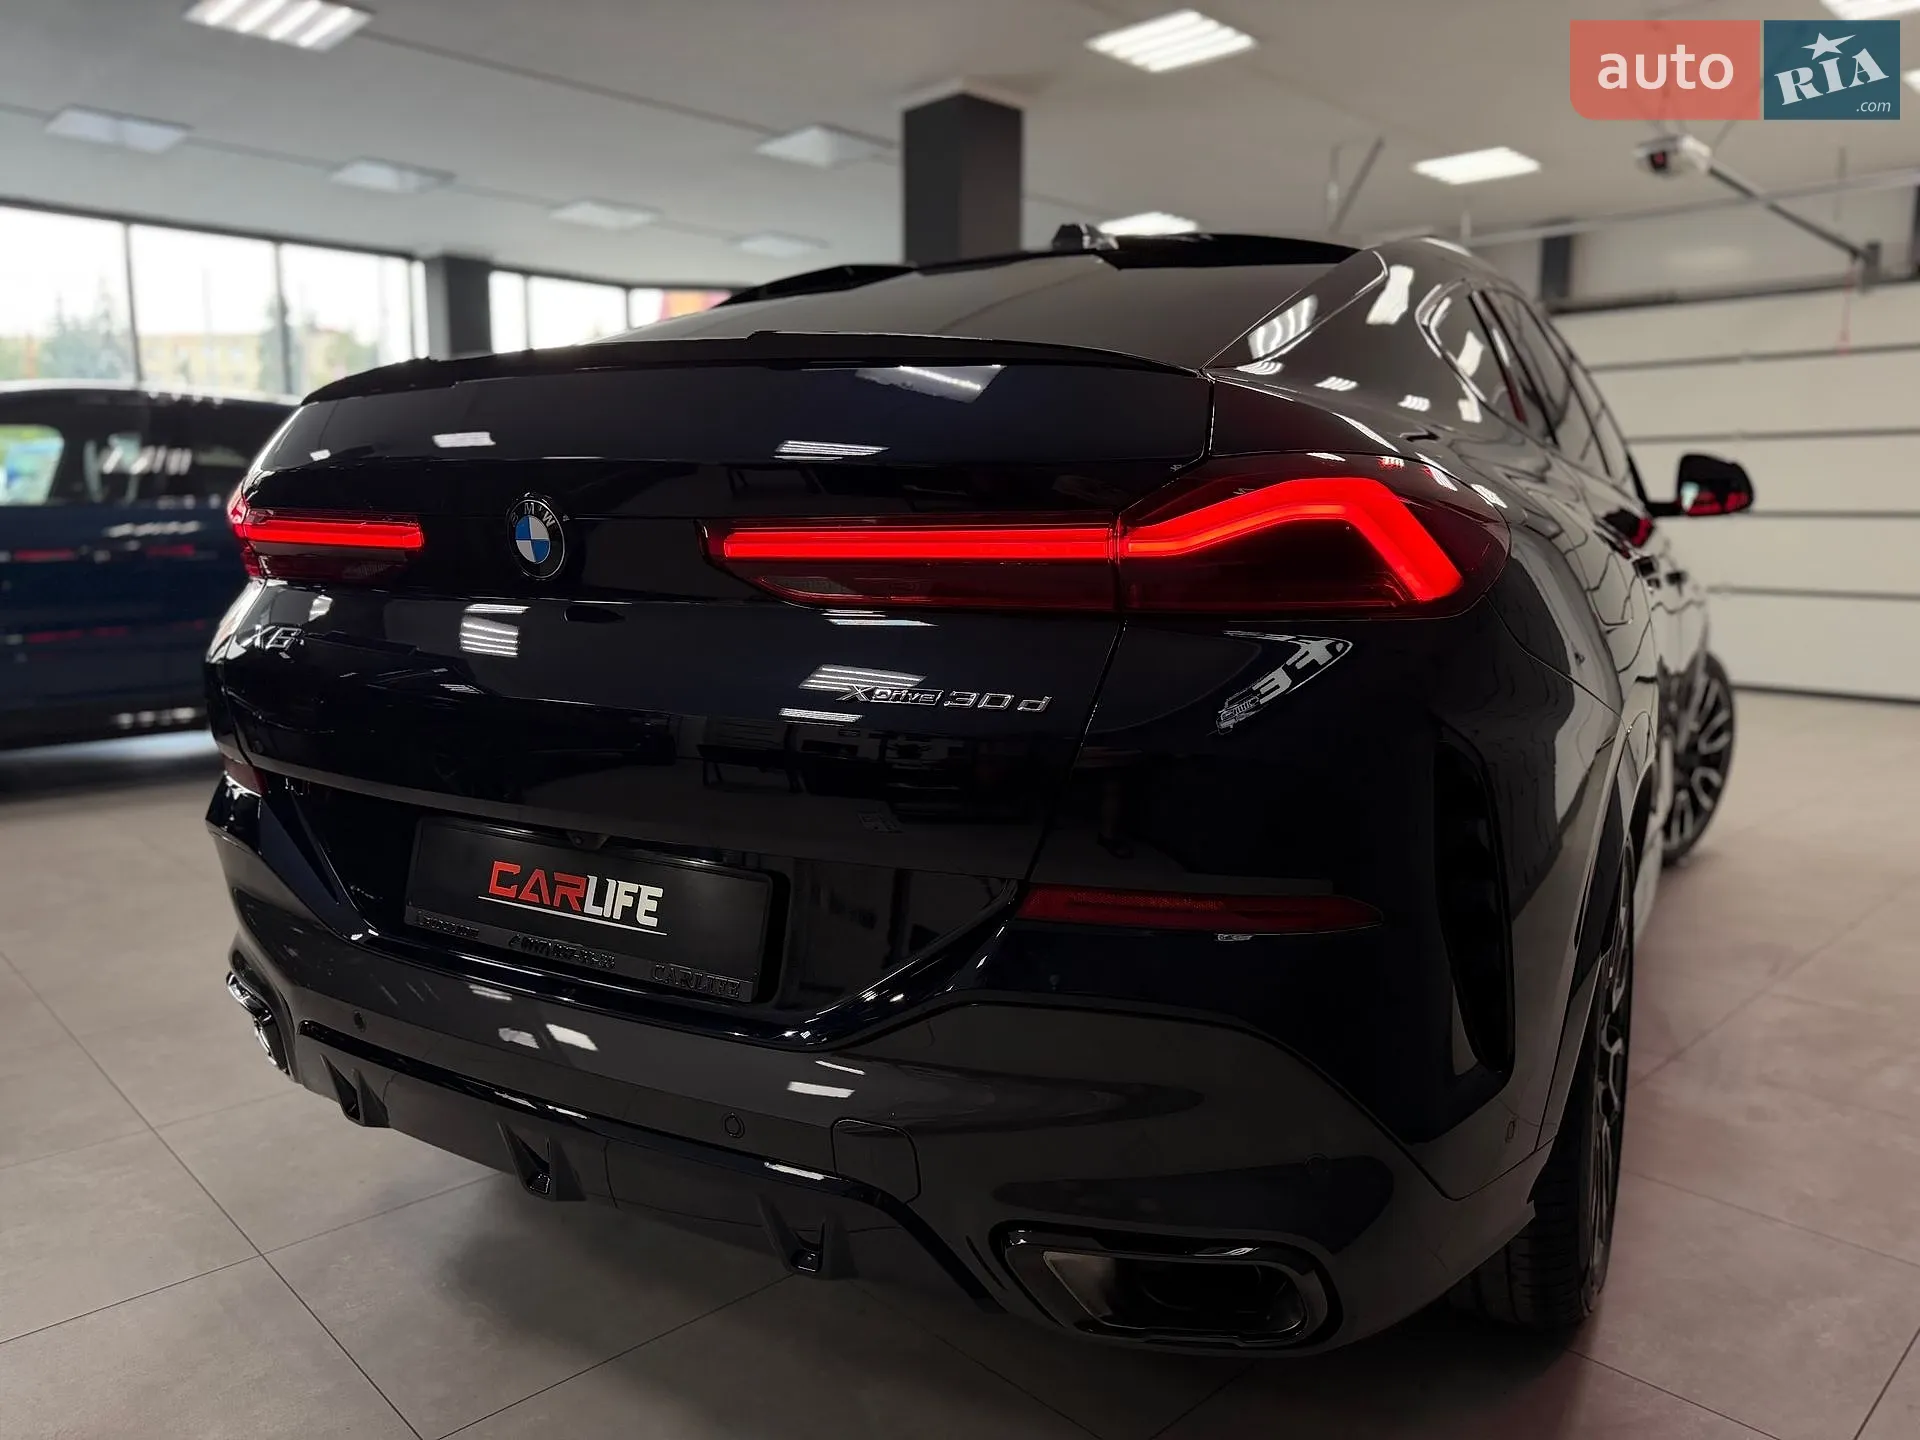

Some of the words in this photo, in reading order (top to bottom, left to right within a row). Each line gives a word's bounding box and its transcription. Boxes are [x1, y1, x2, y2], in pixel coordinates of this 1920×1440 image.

[510, 502, 556, 528] BMW
[240, 625, 302, 650] X6
[488, 860, 664, 928] CARLIFE
